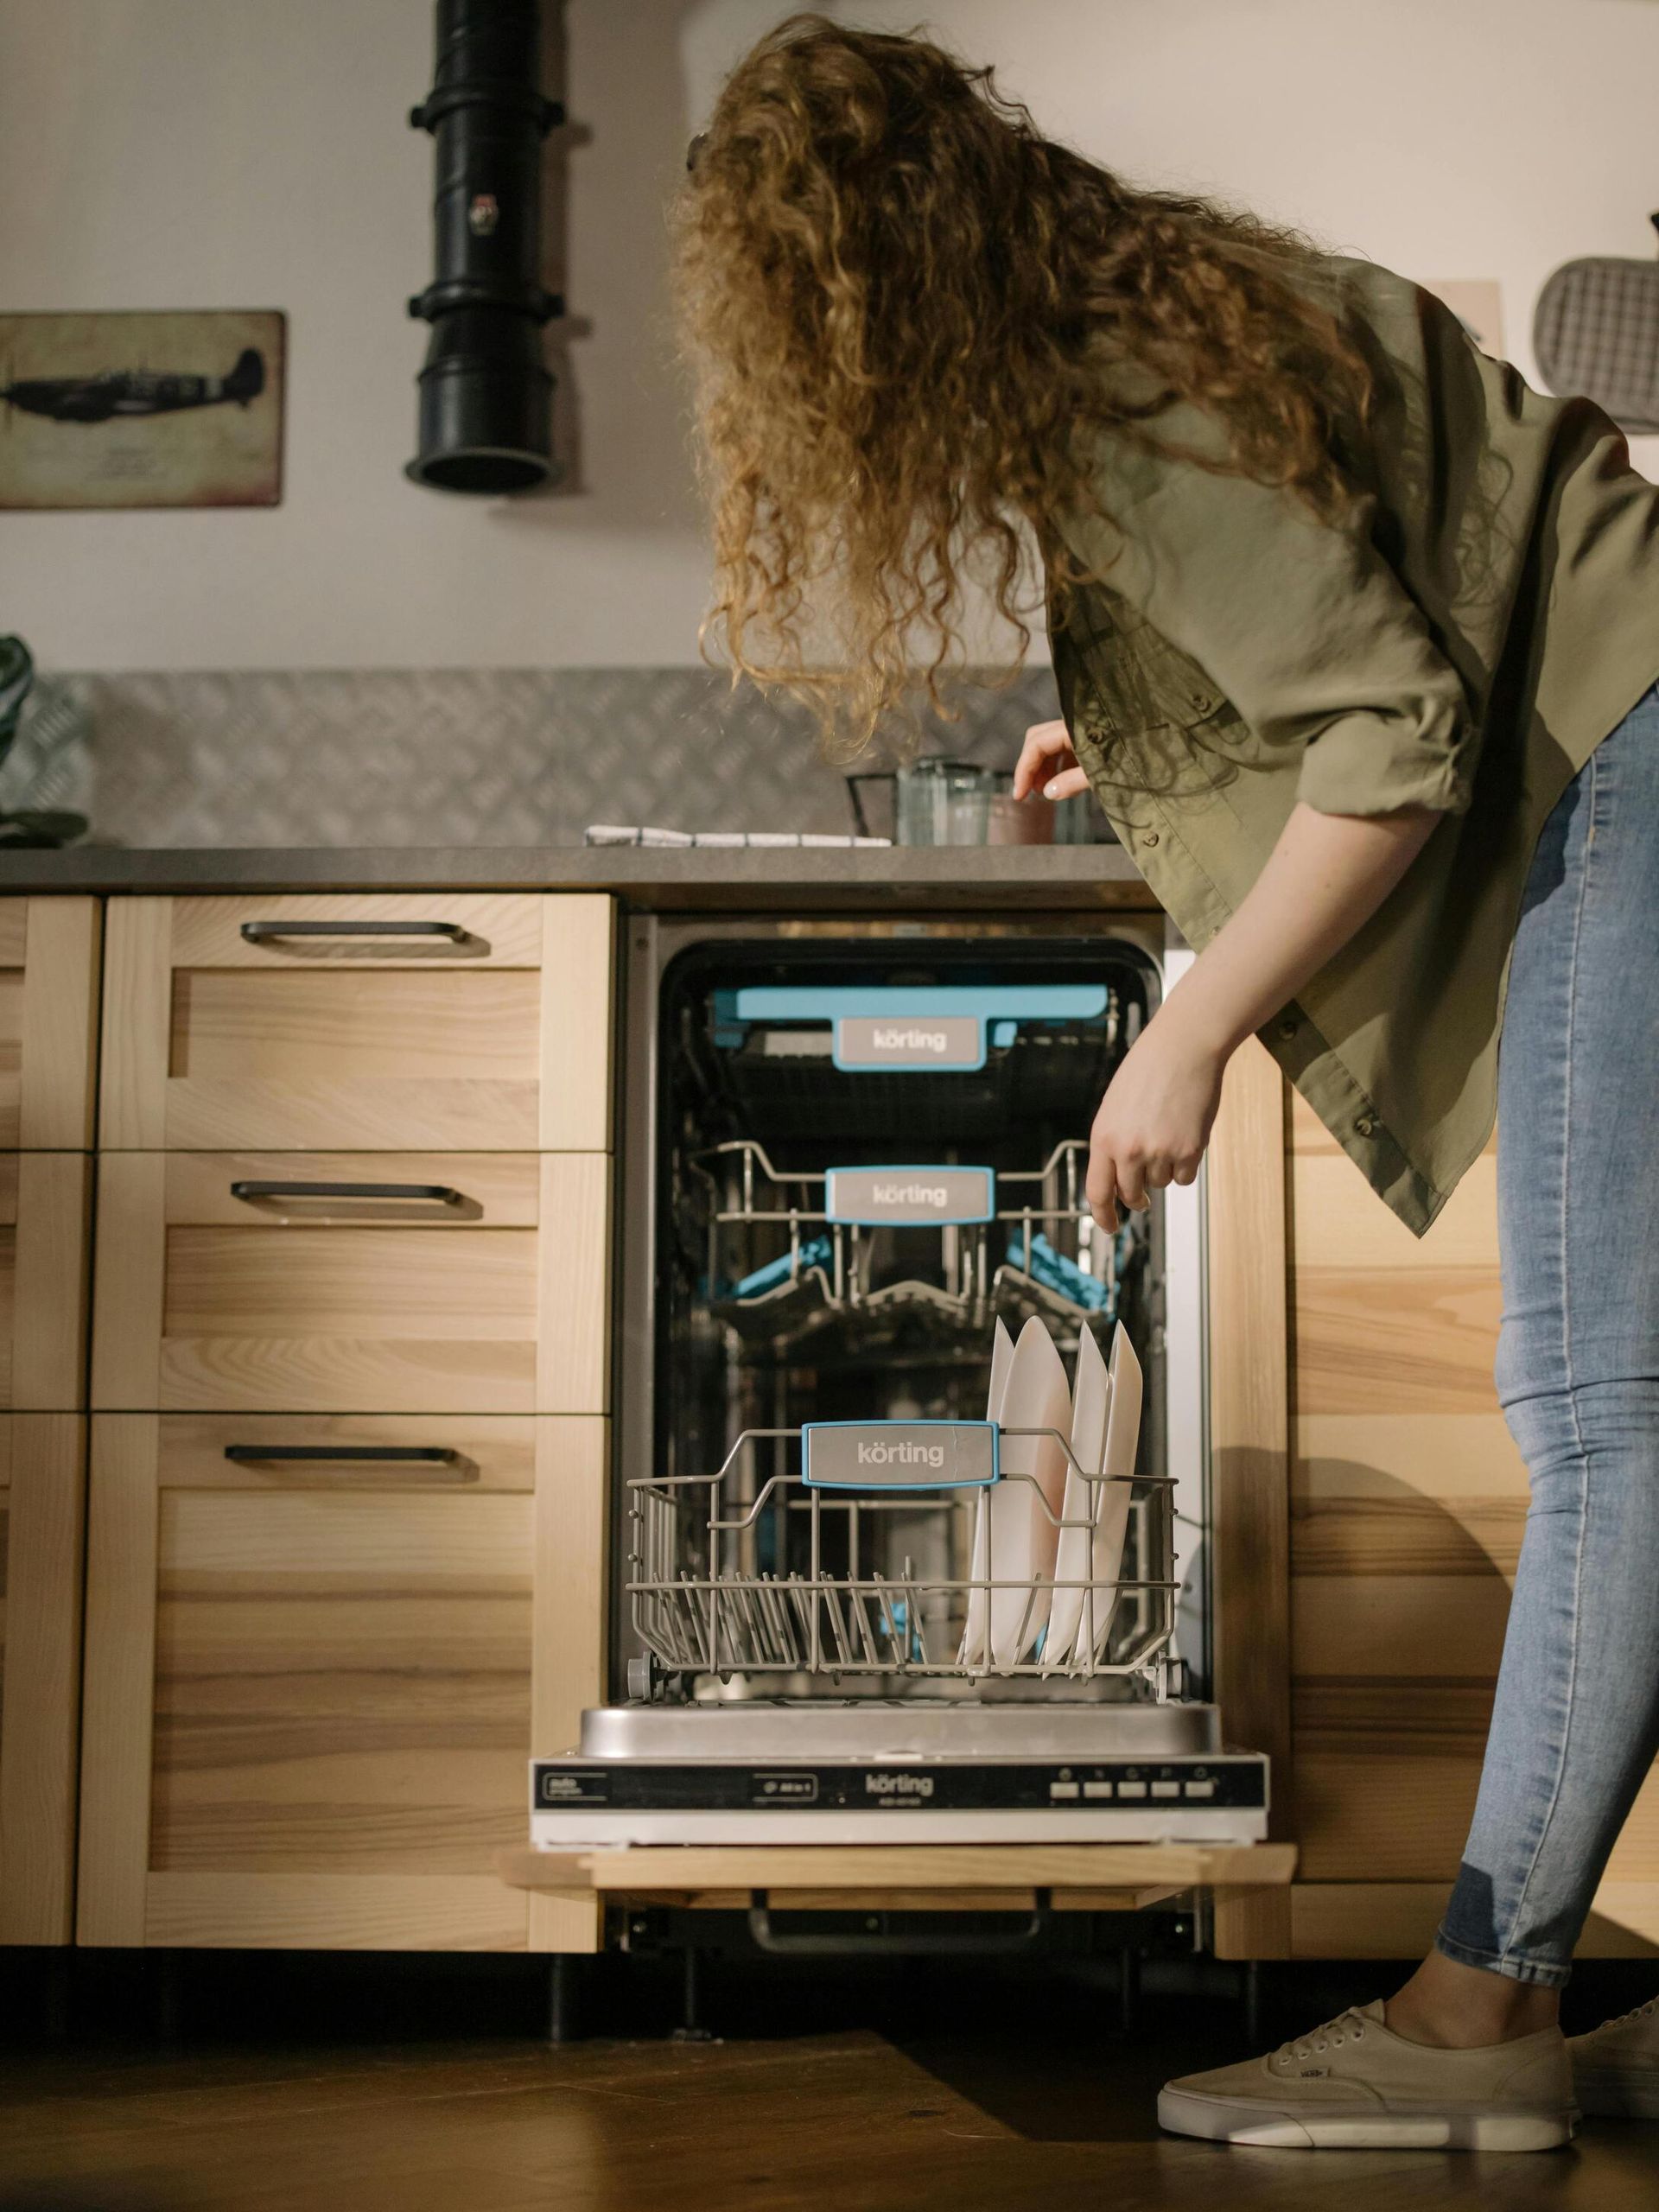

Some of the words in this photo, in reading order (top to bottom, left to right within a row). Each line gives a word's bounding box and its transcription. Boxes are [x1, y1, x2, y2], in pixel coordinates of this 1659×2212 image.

[873, 1029, 947, 1052] körting
[873, 1185, 947, 1208] körting
[857, 1441, 944, 1467] körting
[866, 1773, 934, 1796] körting
